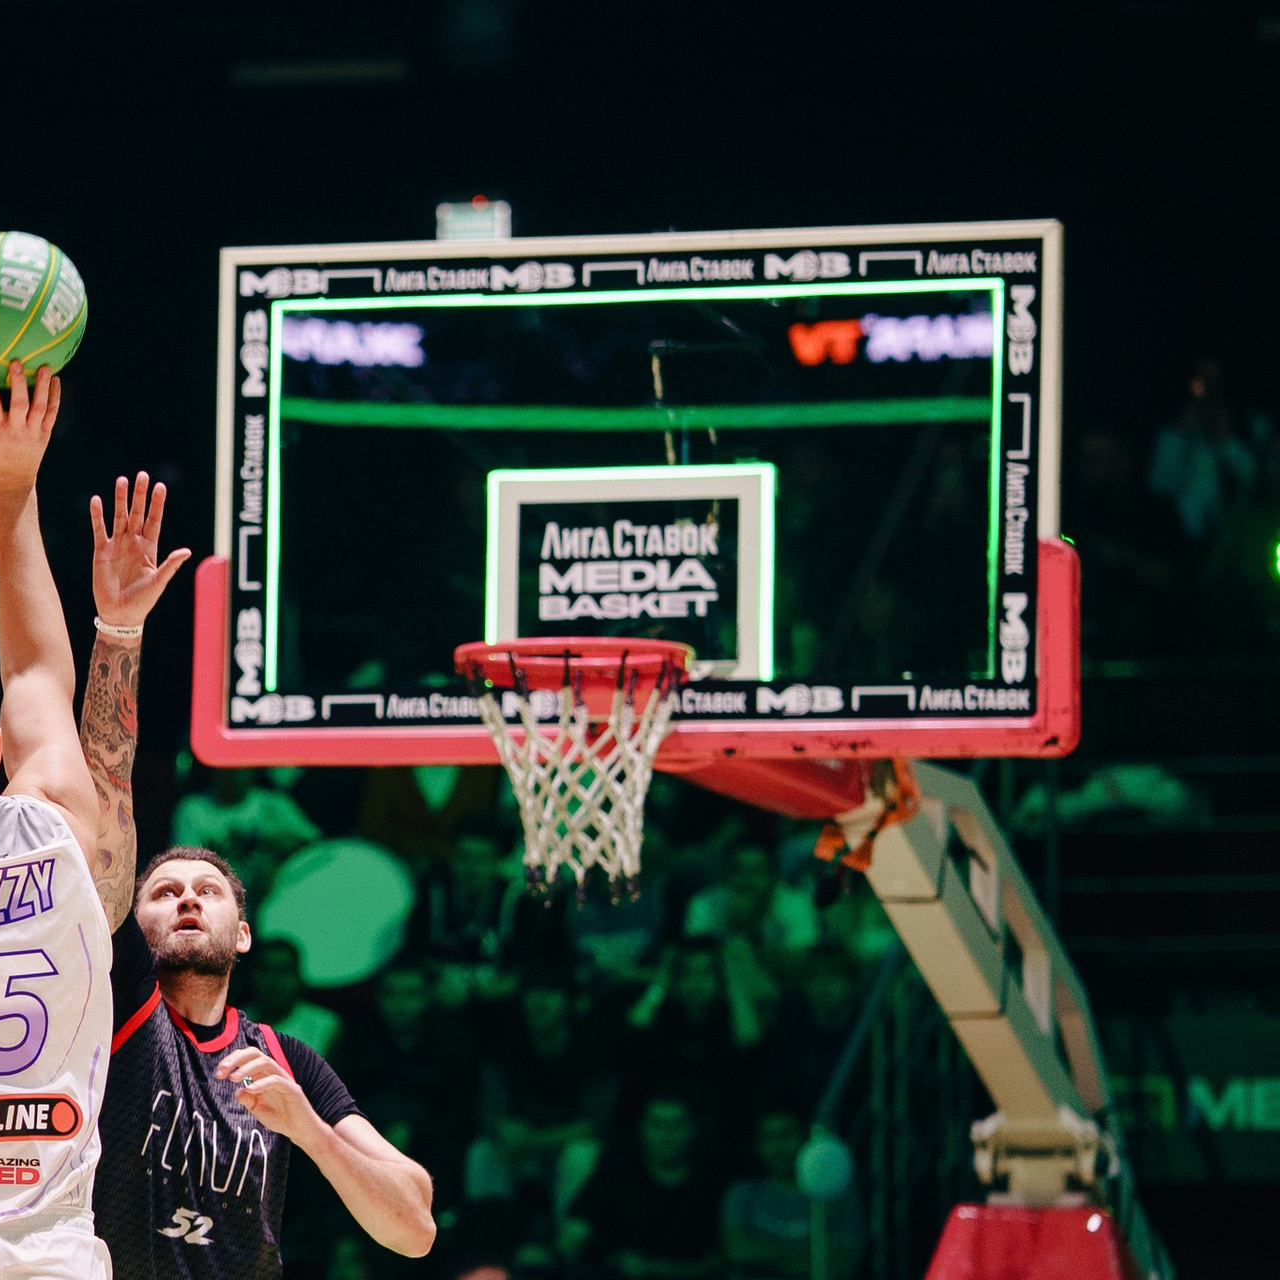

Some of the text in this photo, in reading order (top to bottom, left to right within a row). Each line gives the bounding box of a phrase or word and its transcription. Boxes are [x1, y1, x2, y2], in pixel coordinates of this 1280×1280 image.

[539, 558, 718, 594] MEDIA
[539, 591, 719, 621] BASKET
[156, 1206, 215, 1245] 52
